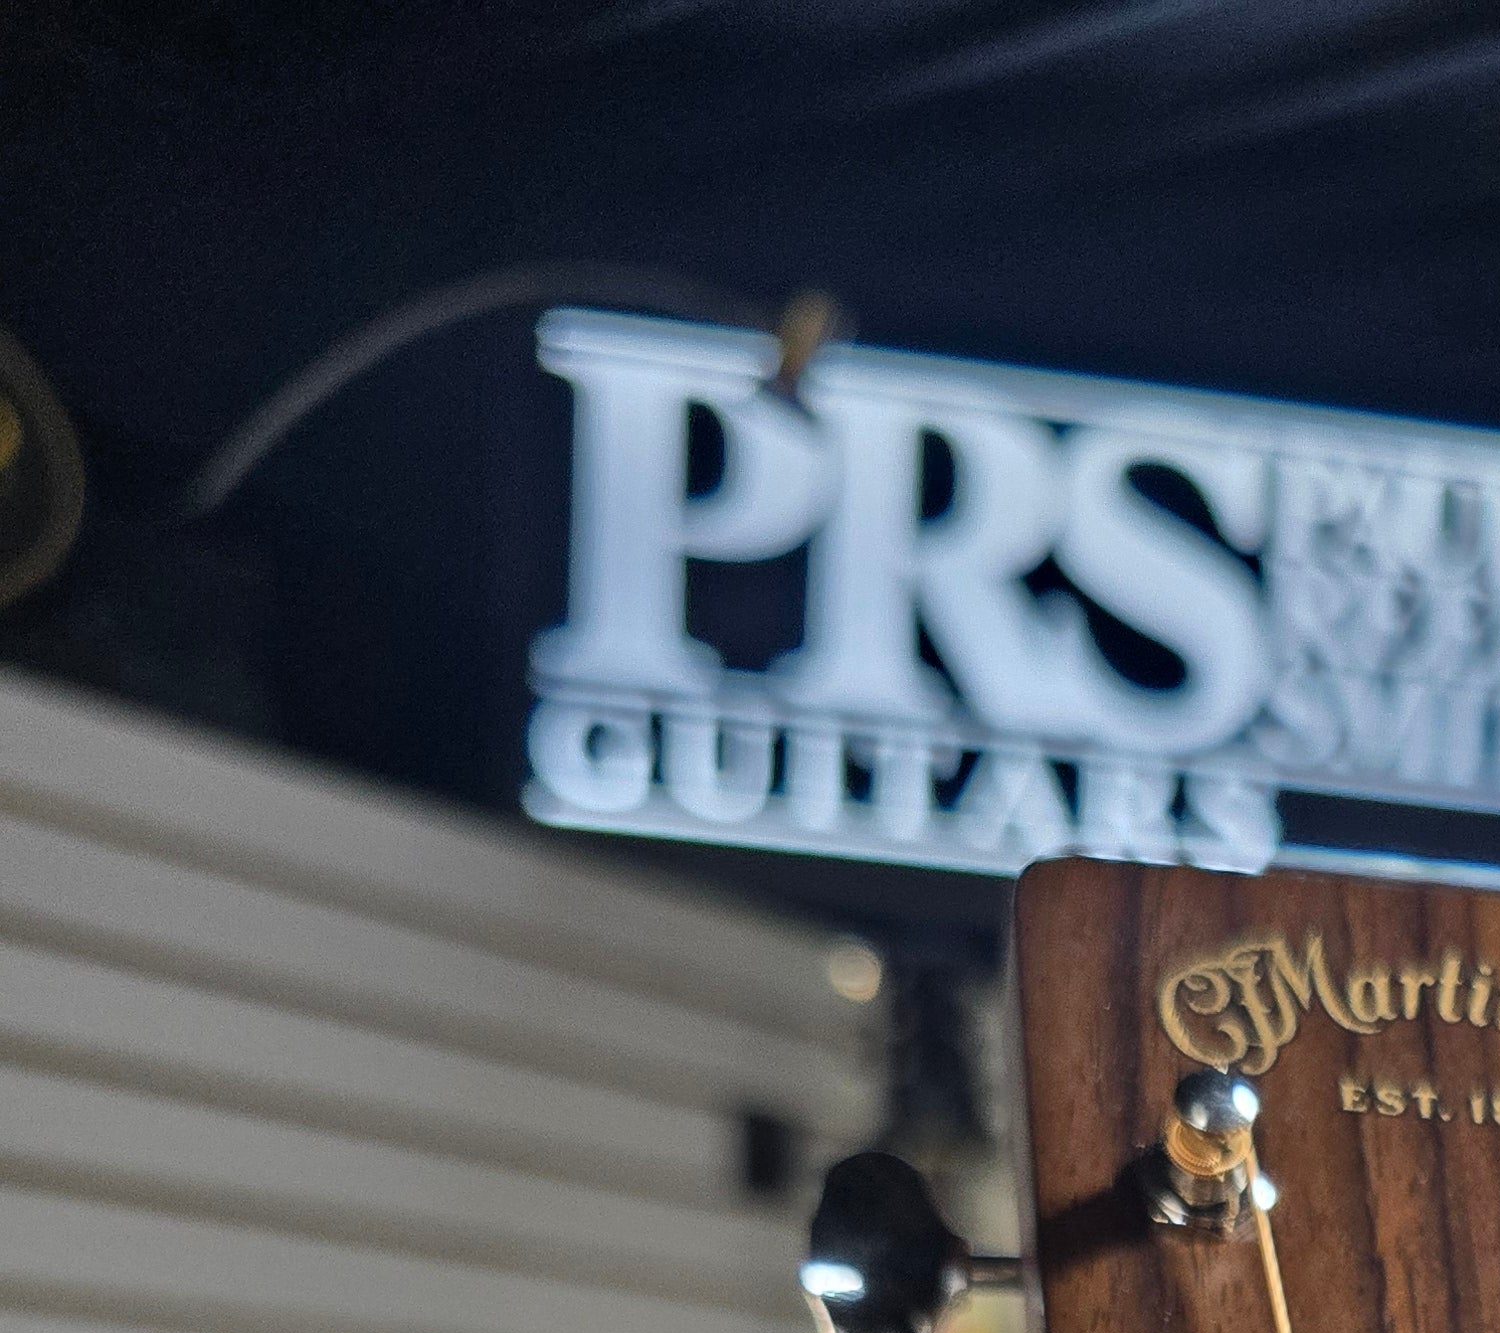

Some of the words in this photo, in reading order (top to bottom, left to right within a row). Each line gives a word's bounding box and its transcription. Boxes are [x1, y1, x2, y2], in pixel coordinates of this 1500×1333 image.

[530, 306, 1272, 760] PRS
[527, 697, 1283, 875] GUITARS
[1339, 1077, 1452, 1122] EST.
